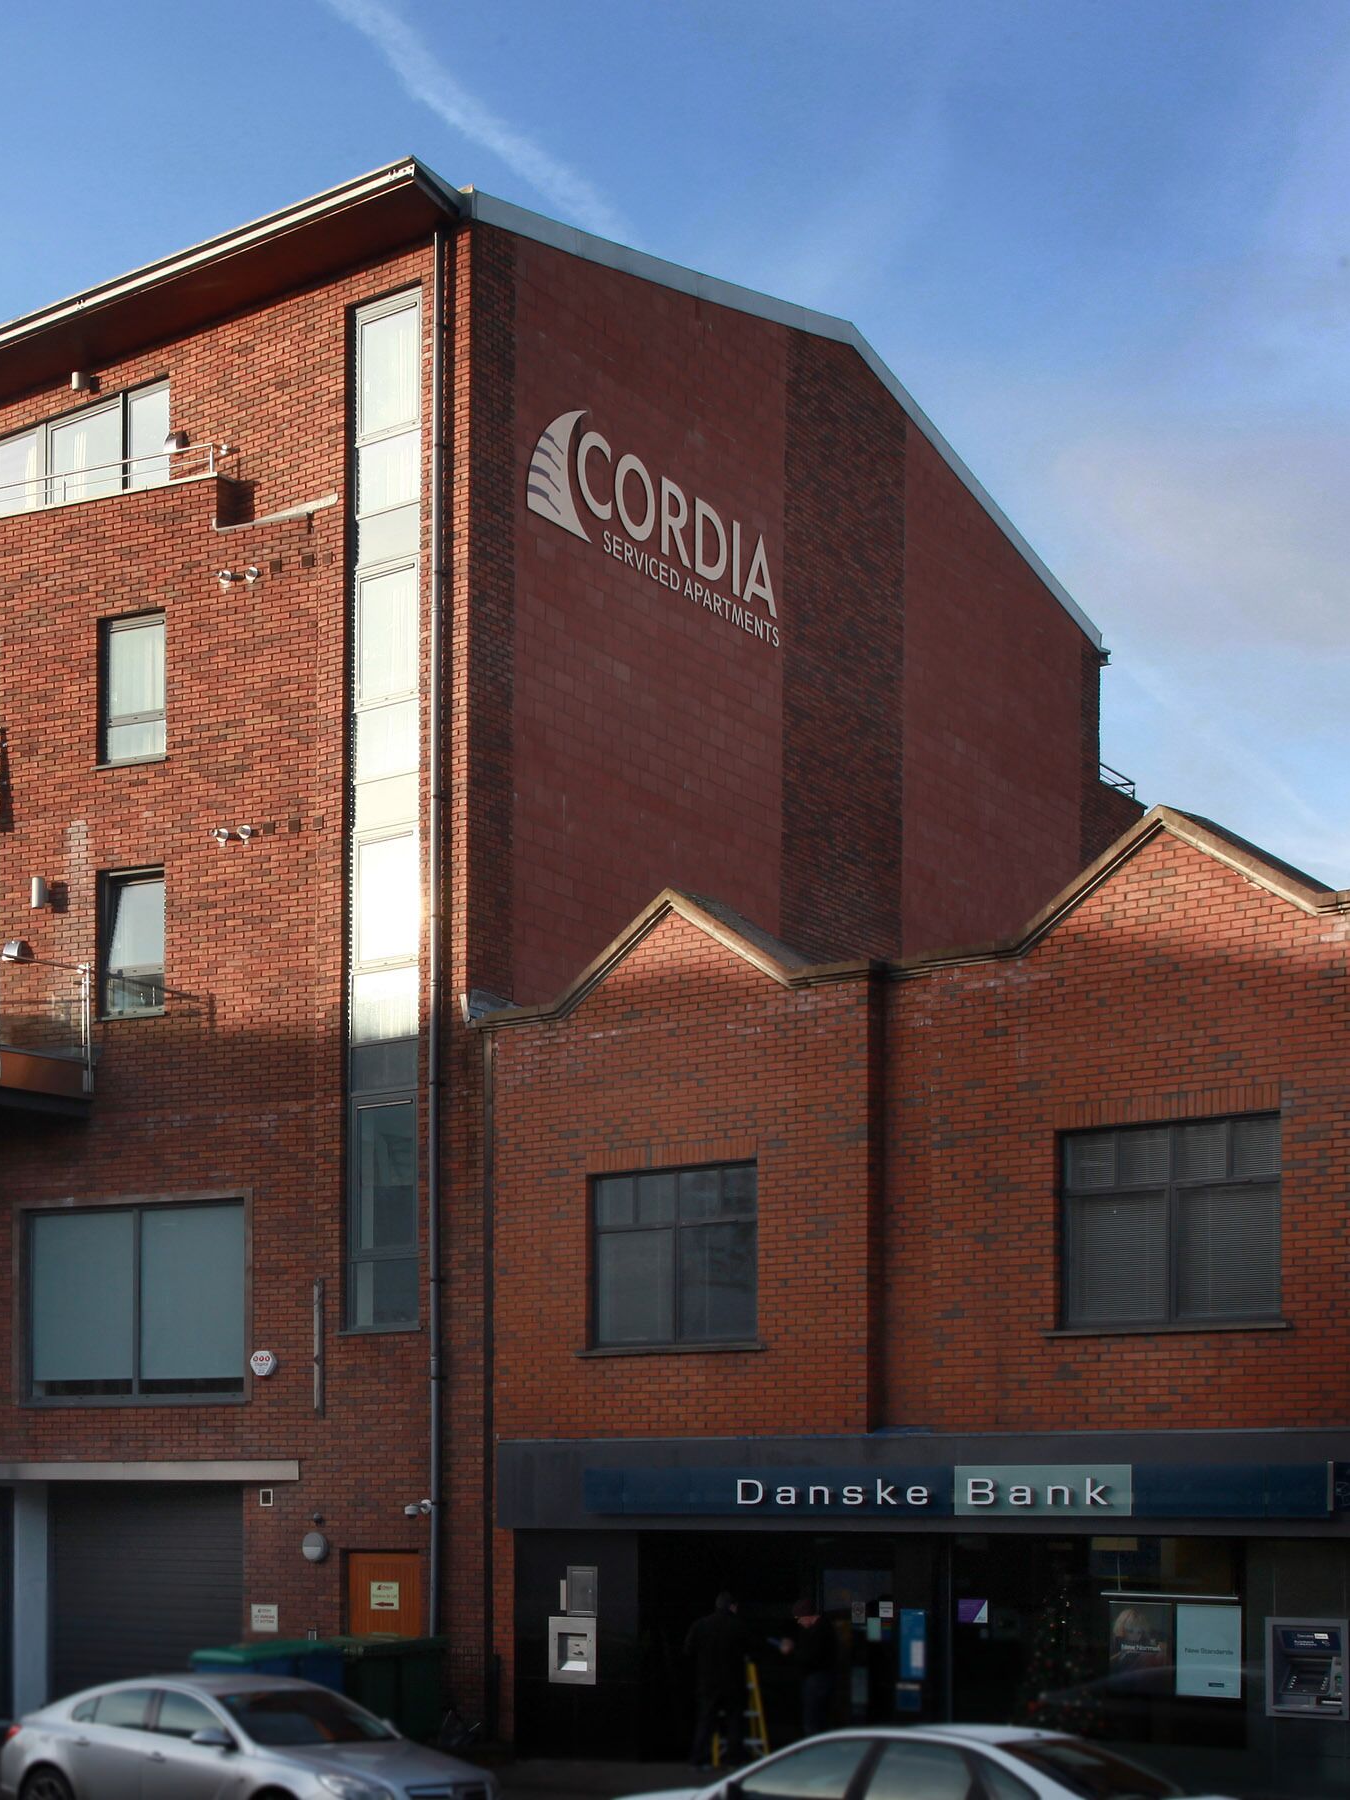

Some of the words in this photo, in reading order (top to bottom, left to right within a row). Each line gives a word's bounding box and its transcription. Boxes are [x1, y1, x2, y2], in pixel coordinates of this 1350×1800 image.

[576, 430, 778, 618] CORDIA
[603, 530, 680, 591] SERVICED
[683, 577, 780, 648] APARTMENTS
[736, 1478, 929, 1506] Danske
[967, 1478, 1110, 1506] Bank
